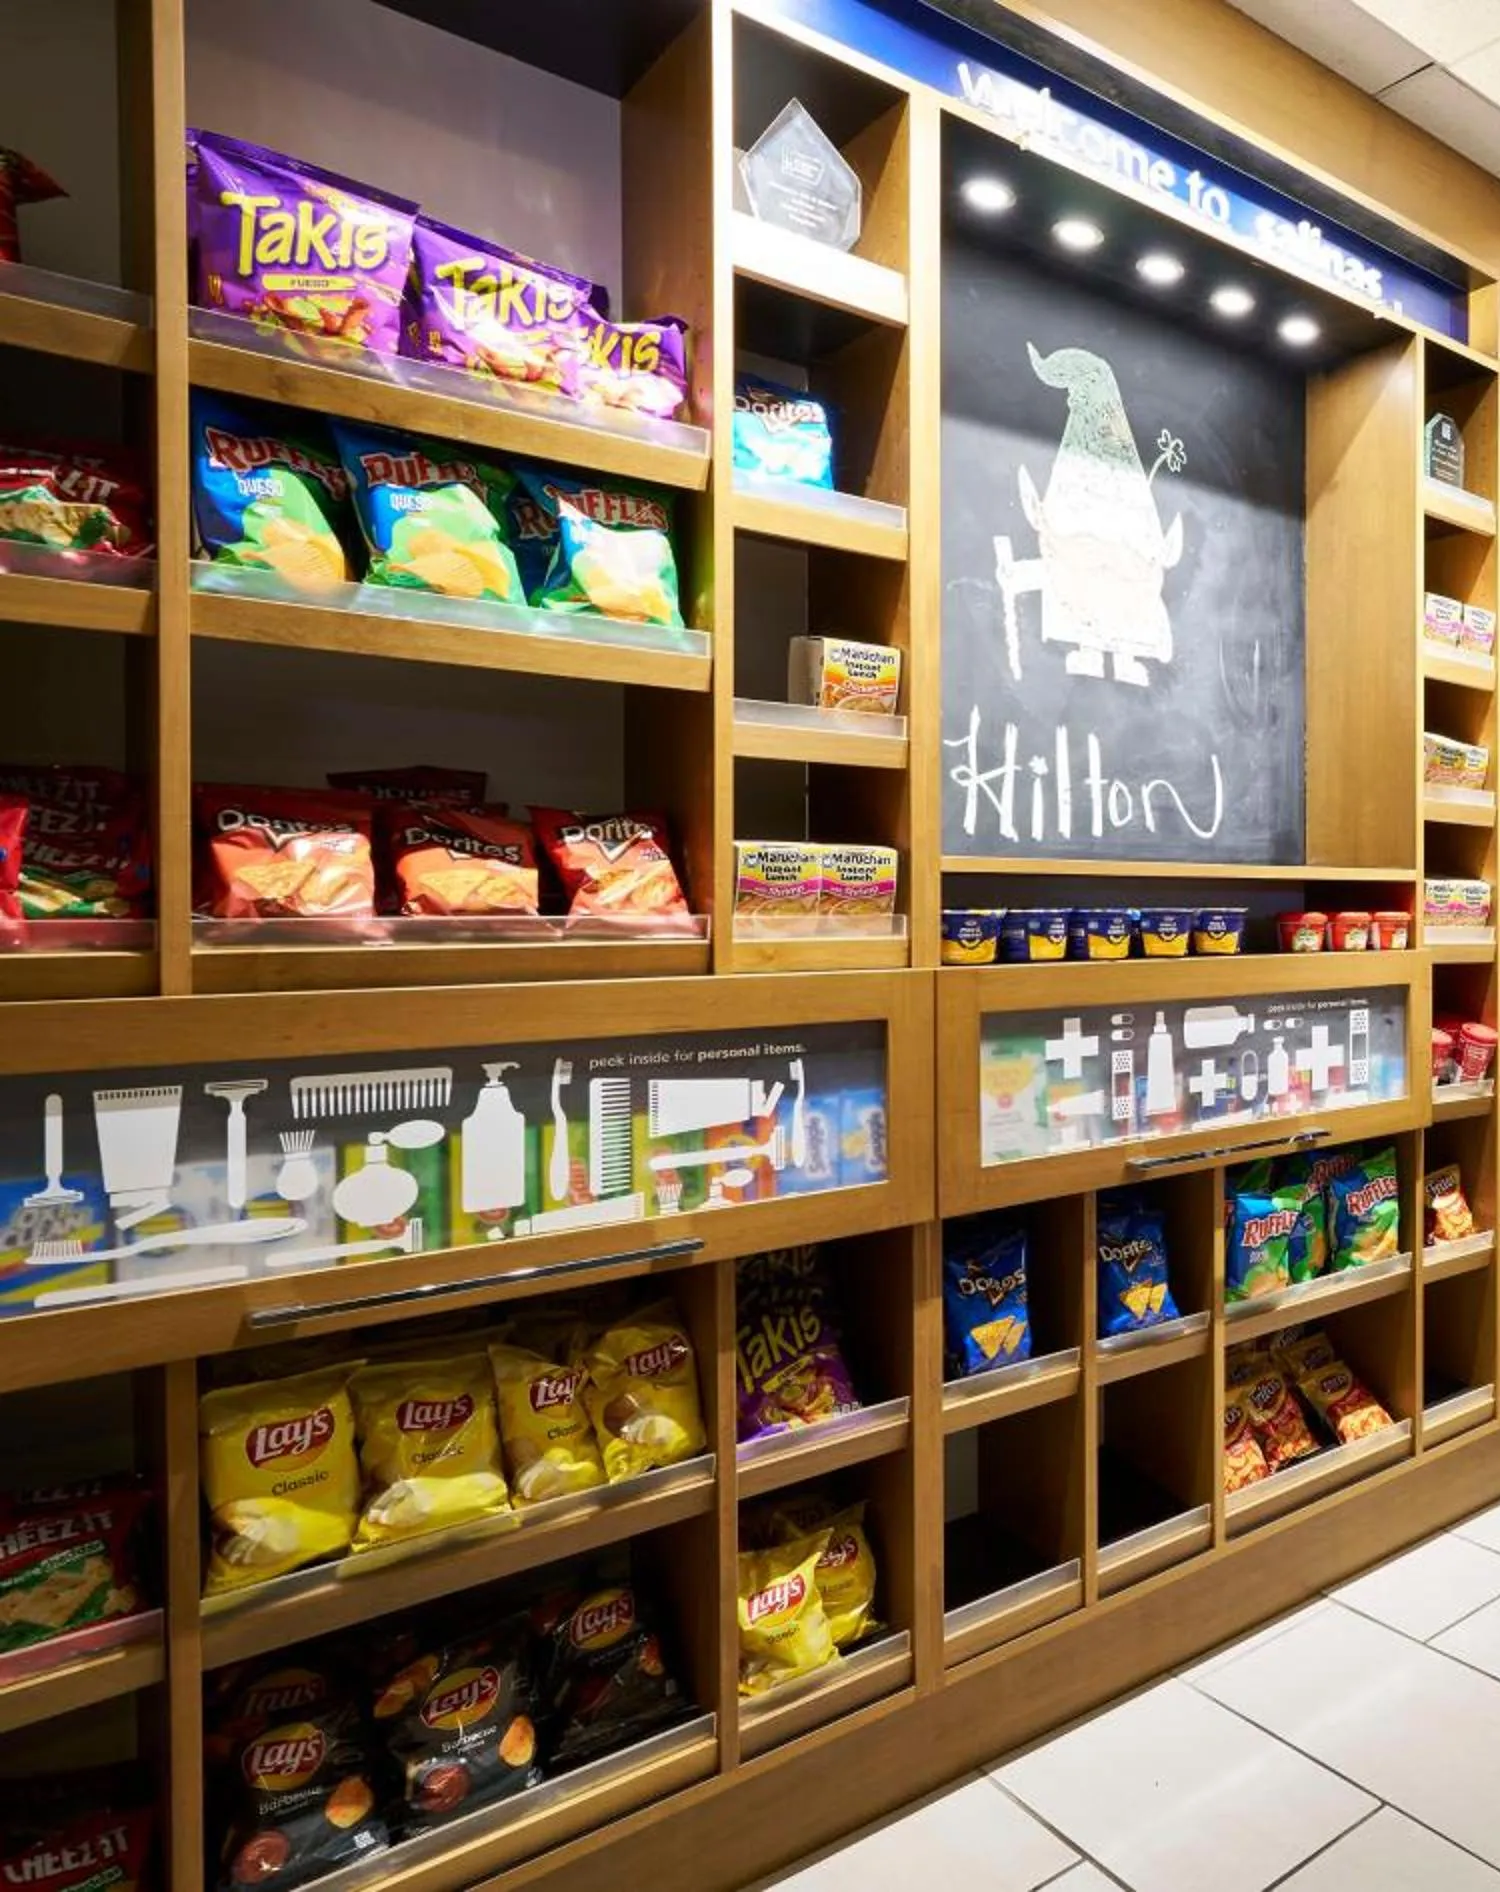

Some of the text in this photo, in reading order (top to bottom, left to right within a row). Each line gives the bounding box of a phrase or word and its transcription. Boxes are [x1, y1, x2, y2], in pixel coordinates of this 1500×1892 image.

[1185, 169, 1231, 224] to
[220, 190, 388, 276] Takis
[435, 257, 575, 328] Takis
[582, 324, 662, 372] kis
[735, 395, 827, 423] Doritos
[390, 492, 432, 512] QUES
[841, 647, 896, 665] Maruchan
[943, 703, 1224, 842] Hilton
[404, 826, 522, 864] Doritos
[757, 851, 817, 864] Maruchan
[832, 852, 892, 866] Maruchan
[629, 1052, 669, 1065] inside
[674, 1049, 693, 1062] for
[698, 1044, 761, 1062] personal
[1241, 1210, 1300, 1247] RUFFL
[736, 1306, 821, 1395] Takis
[402, 1394, 468, 1431] Lay's
[254, 1408, 330, 1461] Lay's
[411, 1443, 465, 1466] Classic
[271, 1468, 330, 1497] Classic
[750, 1573, 802, 1625] Lay's
[575, 1598, 630, 1642] Lay's
[428, 1670, 498, 1722] Lay's
[252, 1733, 320, 1777] Lay's
